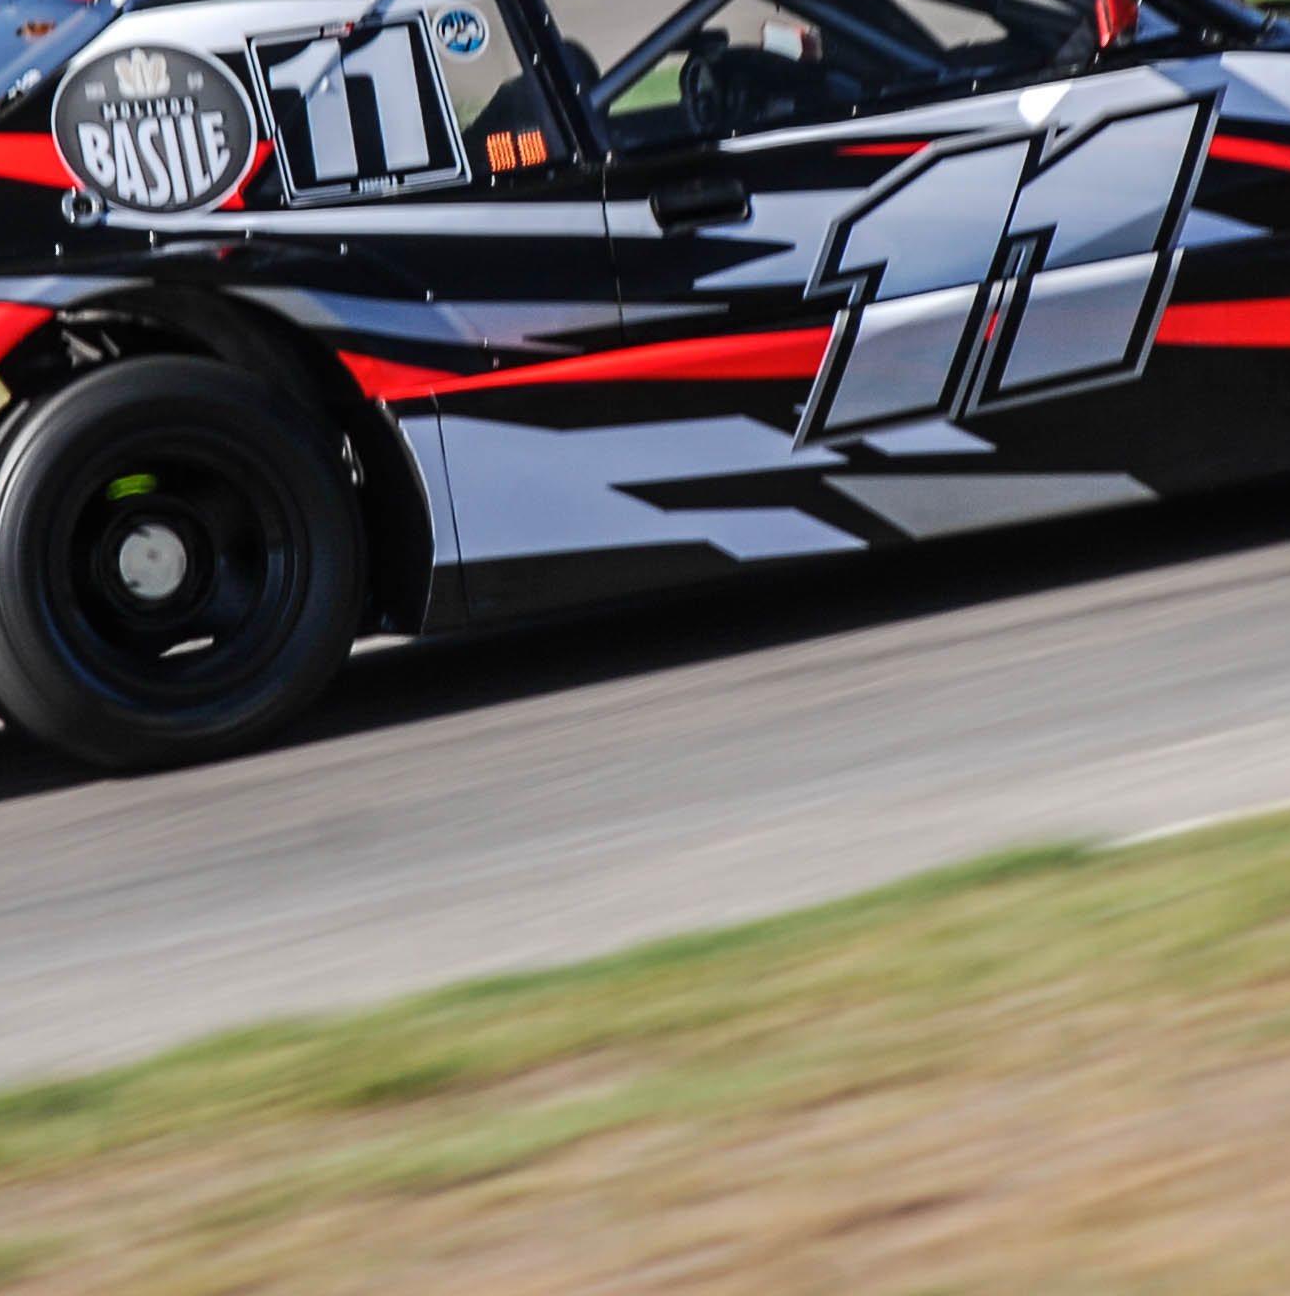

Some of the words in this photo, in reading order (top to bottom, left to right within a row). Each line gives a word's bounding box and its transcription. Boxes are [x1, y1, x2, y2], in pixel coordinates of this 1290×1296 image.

[77, 110, 231, 207] BASILE
[268, 25, 430, 182] 11
[794, 87, 1226, 451] 11
